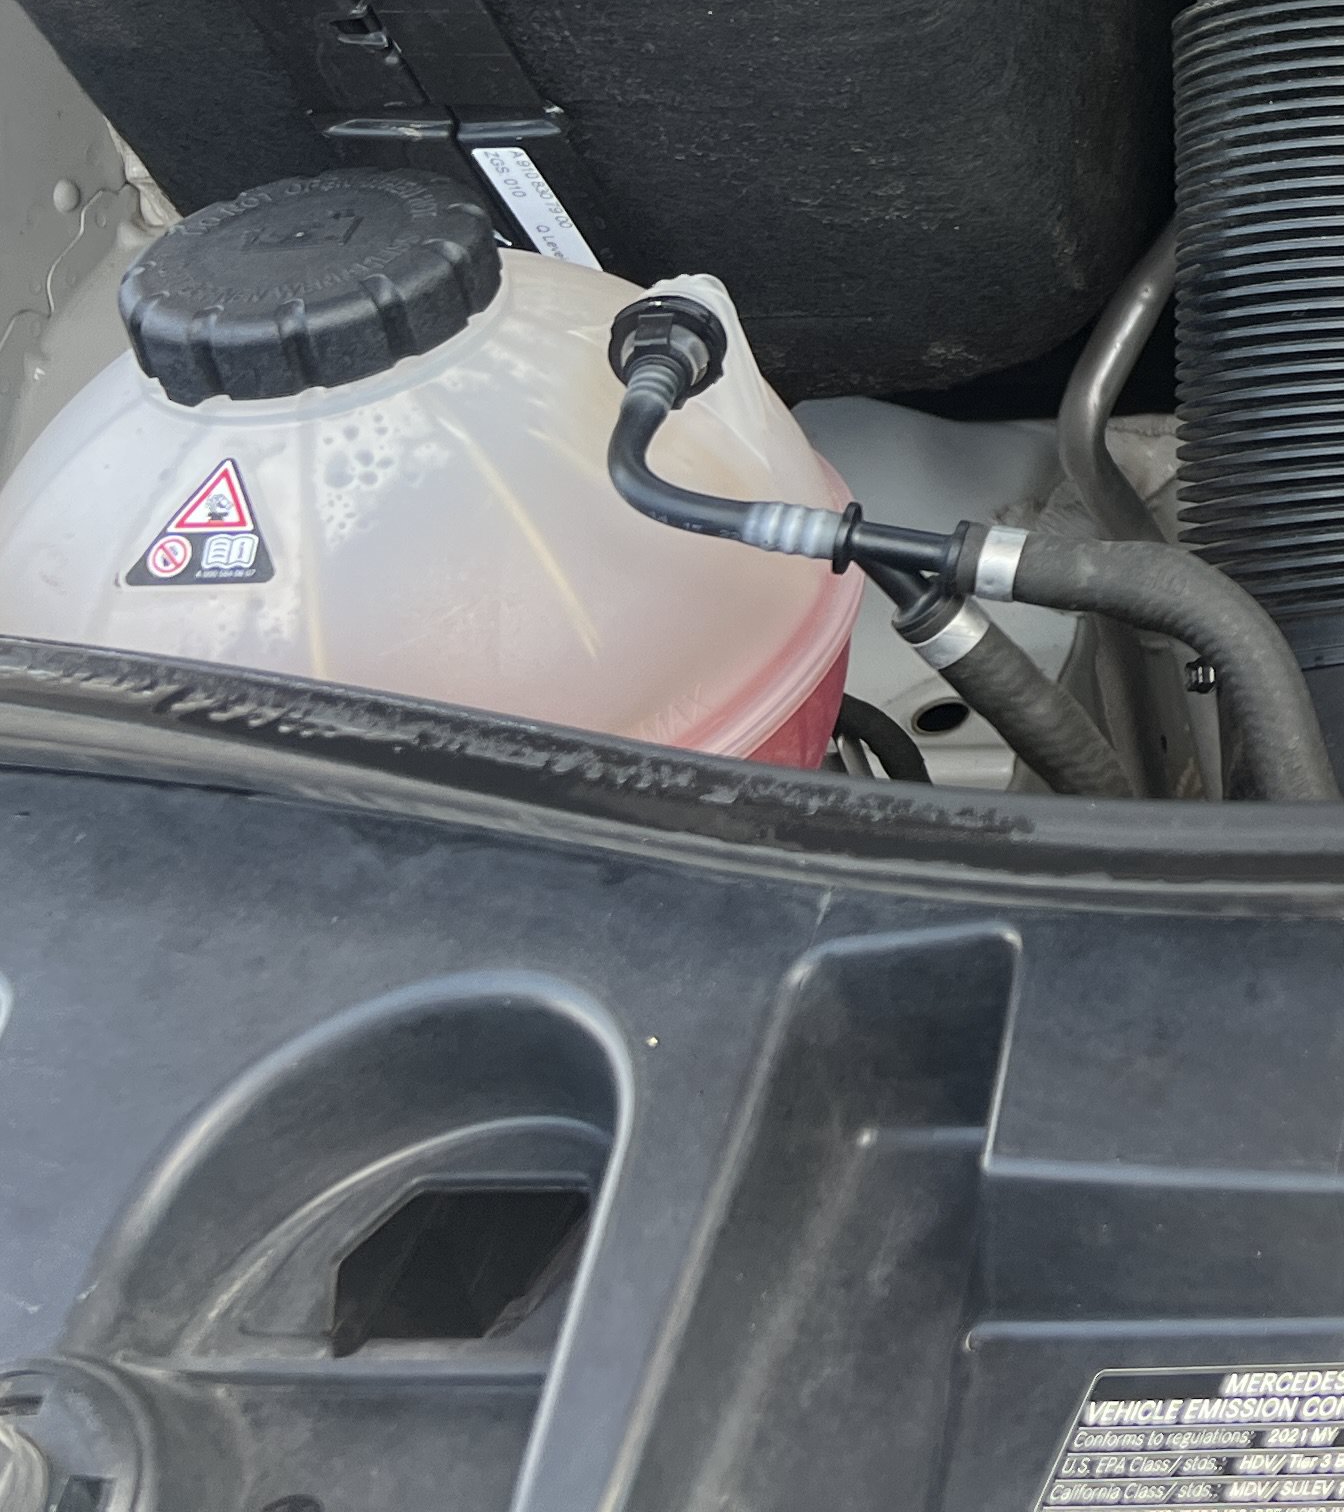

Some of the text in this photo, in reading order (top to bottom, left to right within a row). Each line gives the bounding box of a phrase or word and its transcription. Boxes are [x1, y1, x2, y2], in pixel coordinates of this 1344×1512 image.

[504, 177, 527, 200] 010
[1086, 1399, 1183, 1423] VEHICLE
[1183, 1396, 1299, 1420] EMISSION
[1073, 1431, 1146, 1448] Conforms
[1149, 1431, 1164, 1447] to
[1267, 1428, 1307, 1444] 2021
[1310, 1427, 1339, 1443] MY
[1062, 1457, 1091, 1474] U.S.
[1095, 1456, 1126, 1473] EPA
[1288, 1453, 1316, 1470] Tier
[1320, 1452, 1332, 1468] 3
[1050, 1483, 1120, 1503] California
[1278, 1479, 1334, 1498] SULEV
